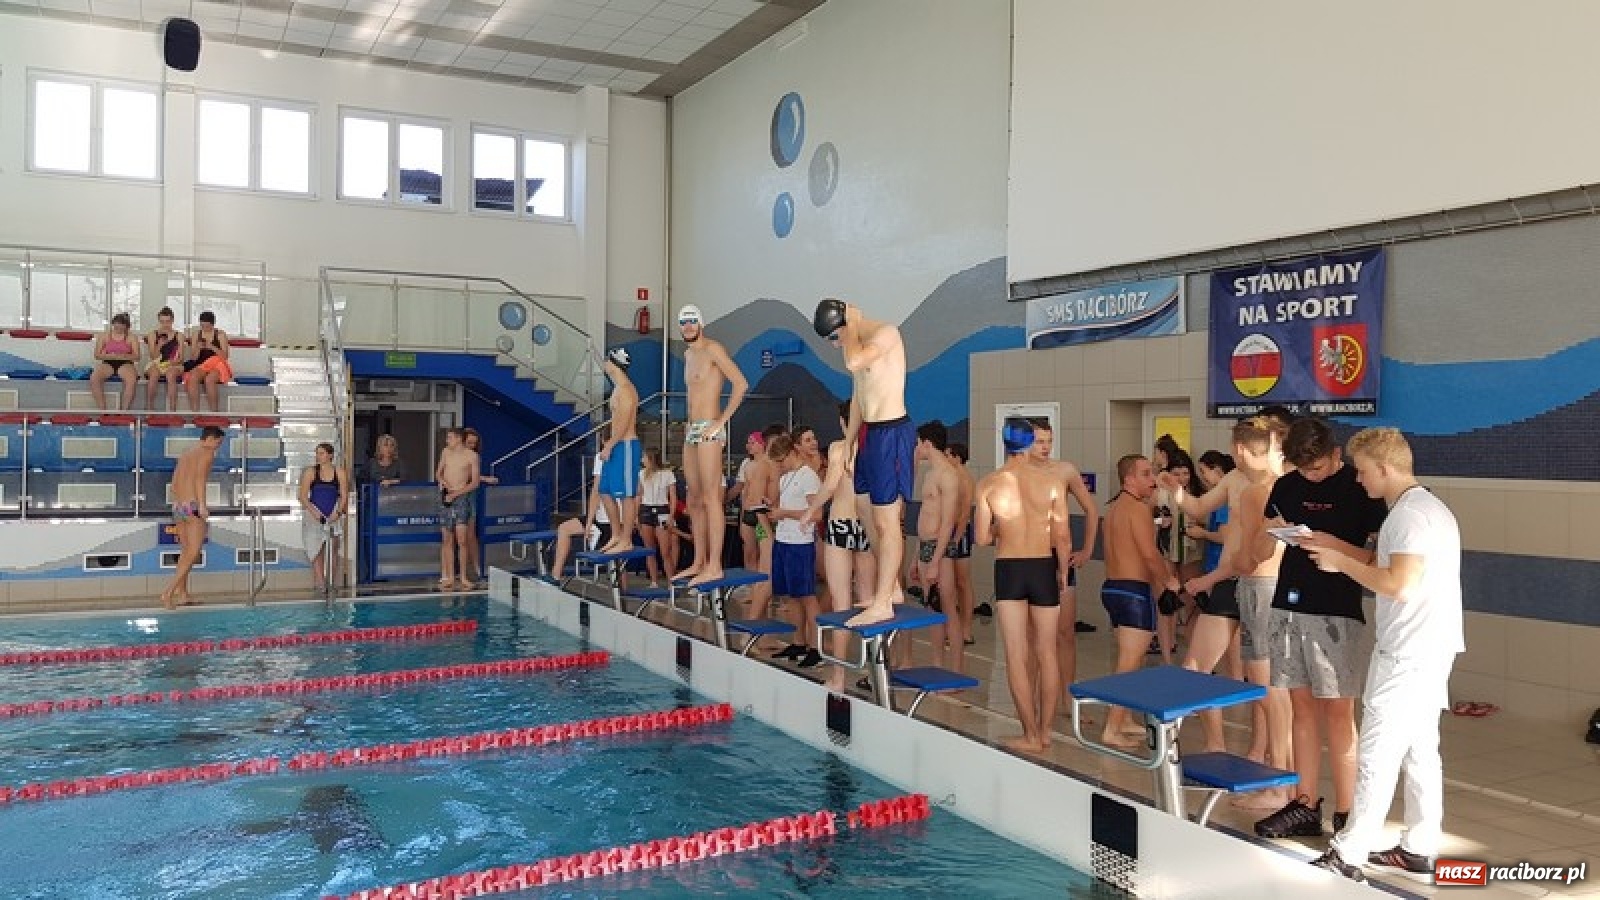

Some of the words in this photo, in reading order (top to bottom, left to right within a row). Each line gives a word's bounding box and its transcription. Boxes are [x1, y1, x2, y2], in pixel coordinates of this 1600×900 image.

[1234, 262, 1362, 297] STAWIAMY
[1046, 301, 1075, 323] SMS
[1077, 288, 1149, 320] RACIBÓRZ
[1239, 303, 1269, 326] NA
[1276, 294, 1358, 323] SPORT
